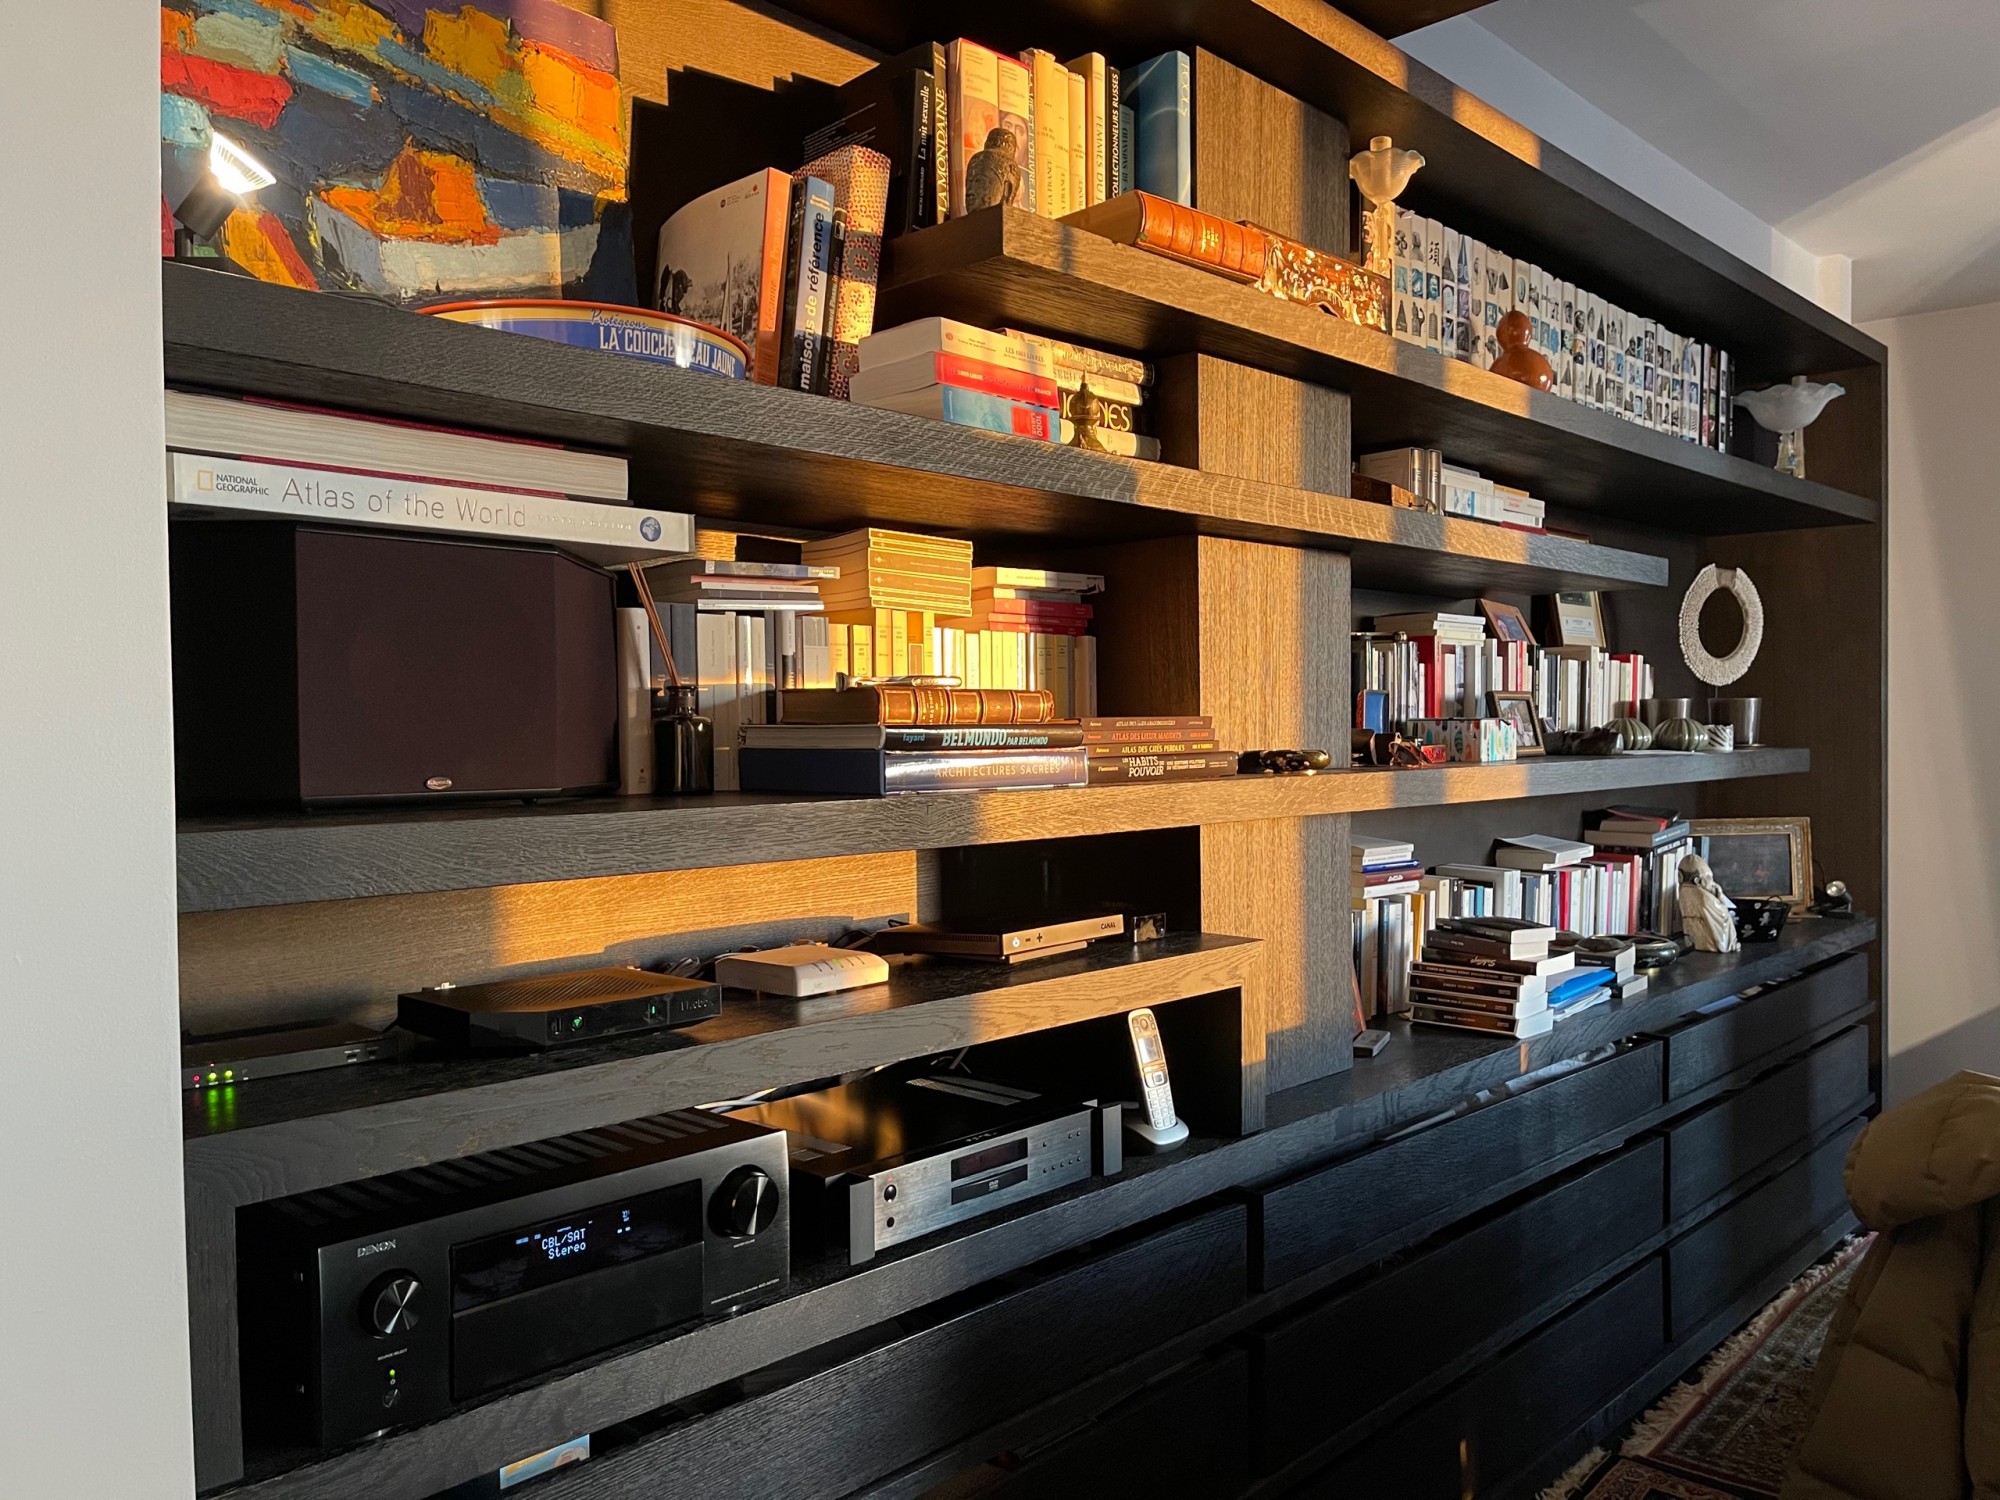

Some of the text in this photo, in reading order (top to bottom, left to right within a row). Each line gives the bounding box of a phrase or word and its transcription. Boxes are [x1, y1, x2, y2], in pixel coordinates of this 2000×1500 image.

[920, 86, 930, 124] sexuelle
[918, 125, 928, 146] nuit
[918, 146, 927, 160] La
[936, 88, 948, 212] LA MONDAINE
[1096, 172, 1104, 193] DU
[808, 212, 825, 293] référence
[804, 296, 817, 316] de
[591, 307, 650, 330] Protégeons
[600, 327, 619, 351] LA
[624, 330, 675, 360] COUCHE
[712, 348, 736, 378] JAUNE
[800, 320, 815, 390] maisons
[216, 473, 258, 486] NATIONAL
[216, 482, 270, 497] GEOGRAPHIC
[282, 478, 526, 528] Atlas of the World
[903, 729, 1048, 746] fayard BELMONDO PAR BELMONDO
[1149, 744, 1162, 752] CITÉS
[1129, 756, 1158, 766] HABITS
[936, 766, 1016, 778] ARCHITECTURES
[1128, 766, 1164, 777] POUVOIR
[1101, 922, 1116, 930] CANAL
[358, 1239, 396, 1257] DENON
[542, 1228, 586, 1250] CBL/SAT
[548, 1242, 586, 1260] Stereo
